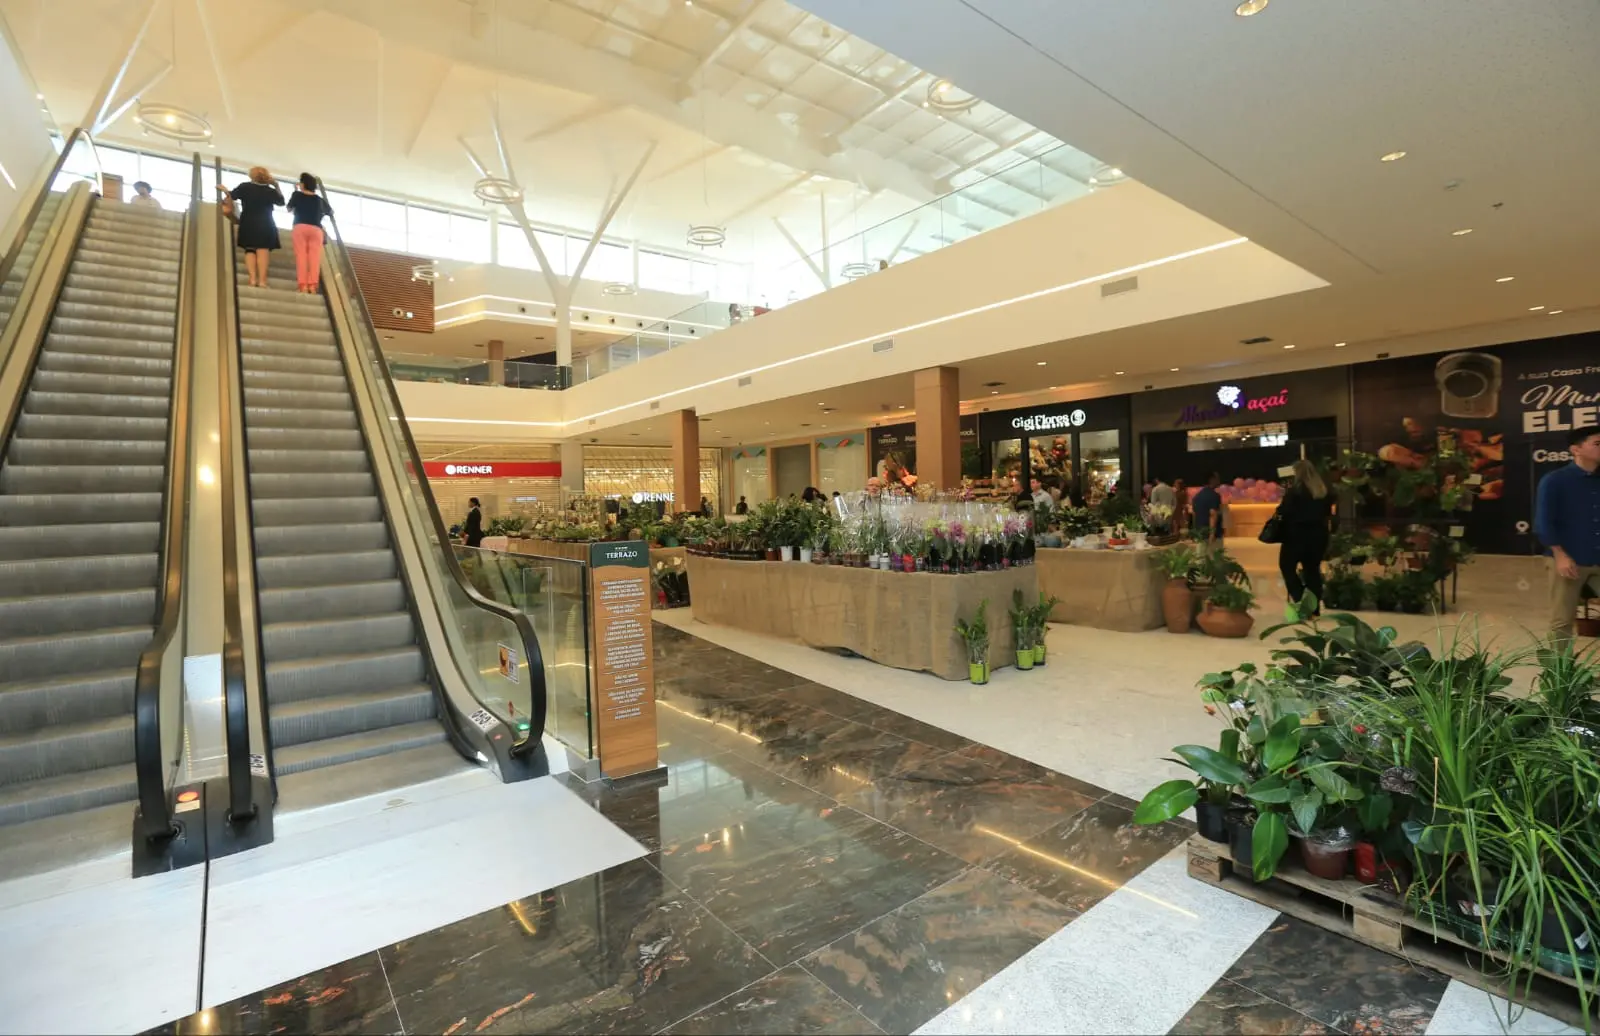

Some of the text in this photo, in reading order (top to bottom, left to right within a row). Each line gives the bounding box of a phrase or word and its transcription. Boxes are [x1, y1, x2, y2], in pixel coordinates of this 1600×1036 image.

[1551, 368, 1583, 377] Casa
[1247, 388, 1288, 413] açaí
[1012, 416, 1034, 431] Gigi
[1035, 415, 1069, 428] Flores
[1523, 406, 1600, 433] ELE
[1533, 449, 1574, 463] Cas
[456, 465, 493, 474] RENNER
[643, 492, 675, 502] RENNE
[605, 551, 638, 559] TERRAZO
